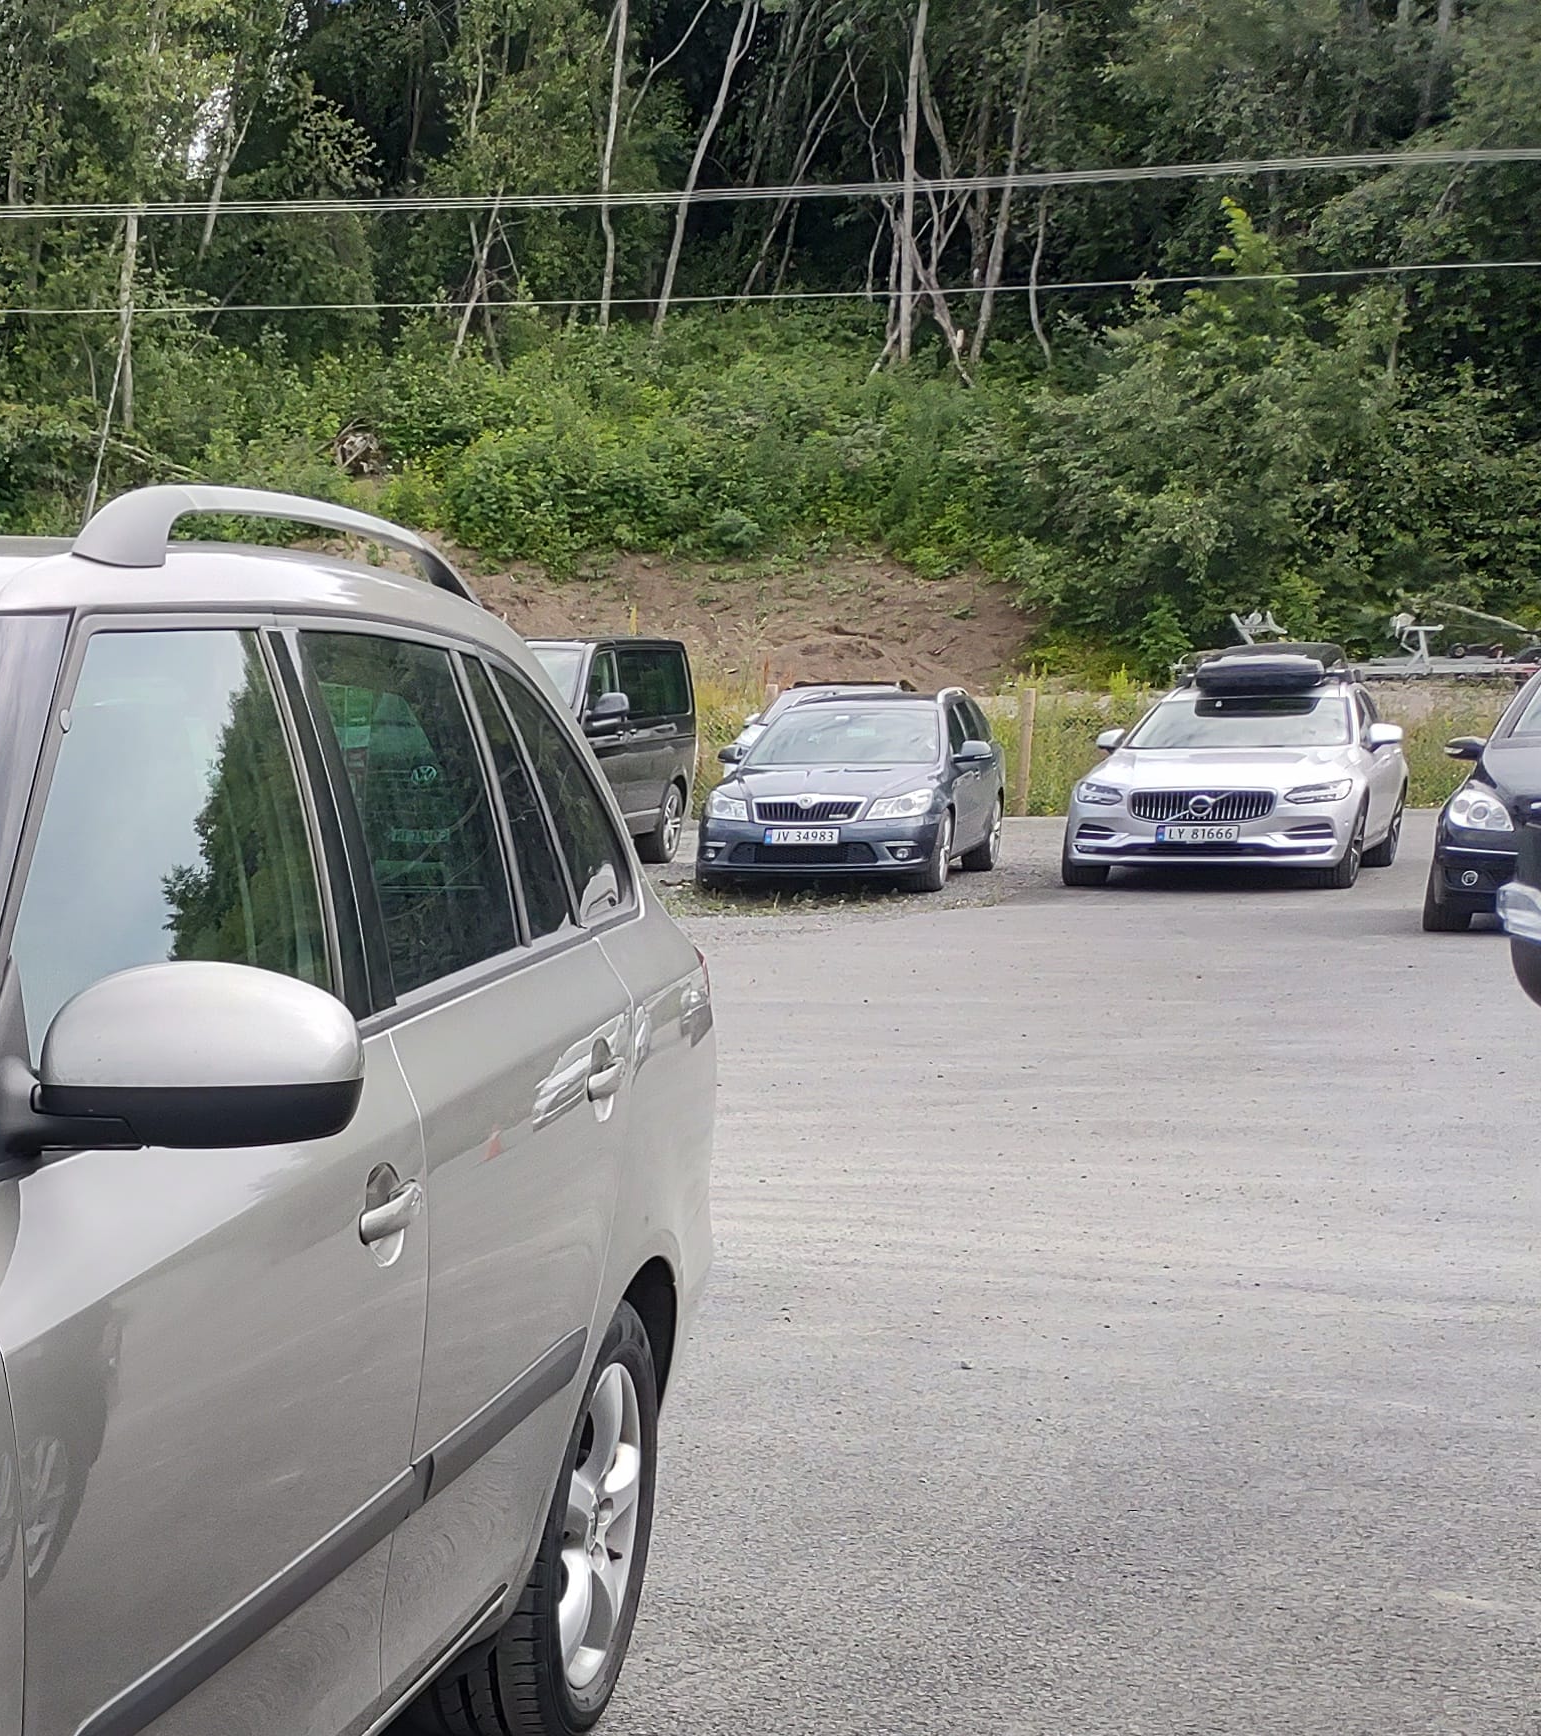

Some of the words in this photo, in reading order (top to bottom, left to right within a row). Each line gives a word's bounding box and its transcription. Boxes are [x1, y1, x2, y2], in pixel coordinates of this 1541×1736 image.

[775, 831, 790, 842] JV
[796, 831, 834, 842] 34983
[1168, 828, 1184, 840] LY
[1191, 828, 1233, 840] 81666
